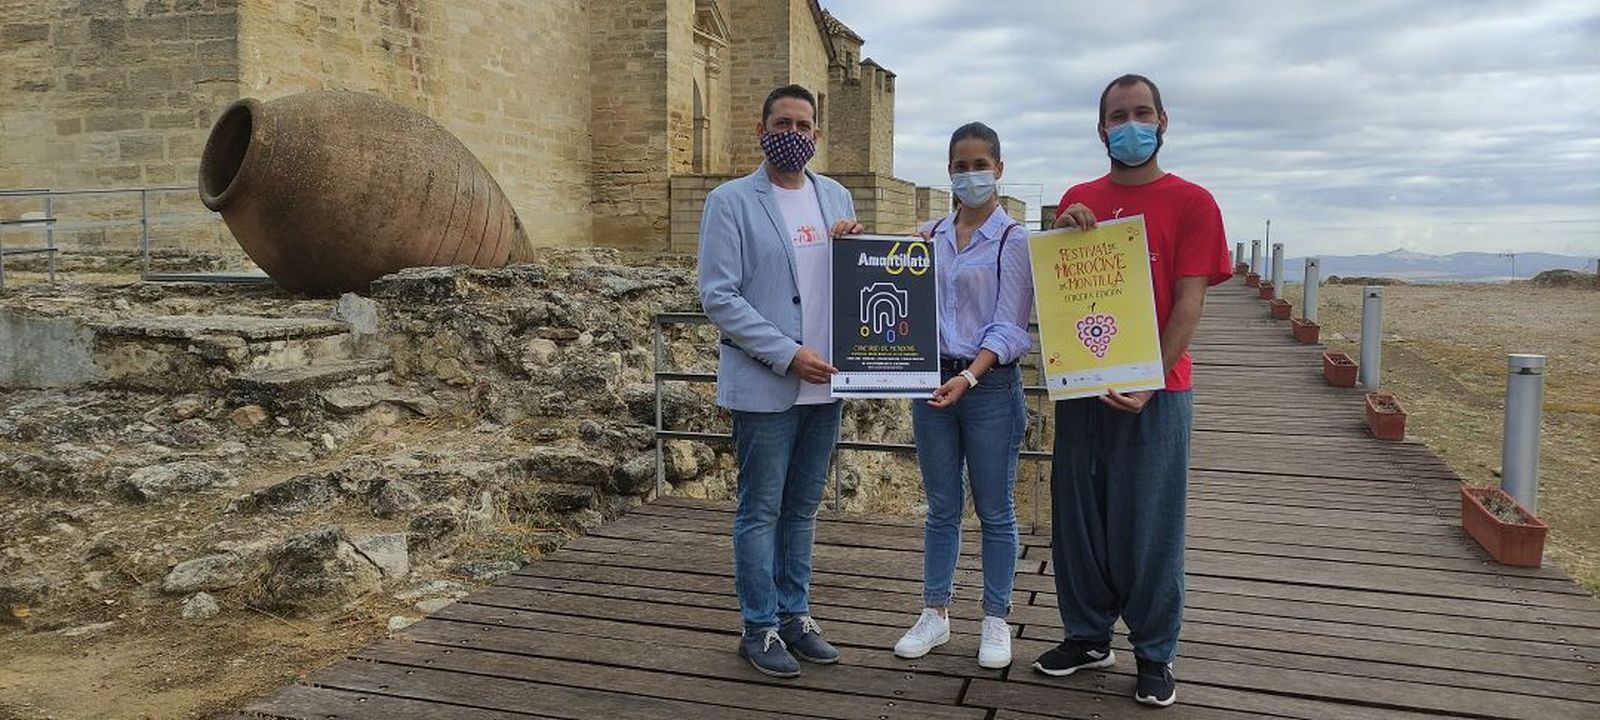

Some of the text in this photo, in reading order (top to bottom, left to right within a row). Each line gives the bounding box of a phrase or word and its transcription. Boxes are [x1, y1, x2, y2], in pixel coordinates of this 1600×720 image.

[1059, 242, 1109, 261] FESTIVAL
[1054, 253, 1127, 279] MICROCINE
[1068, 271, 1125, 290] MONTILLA
